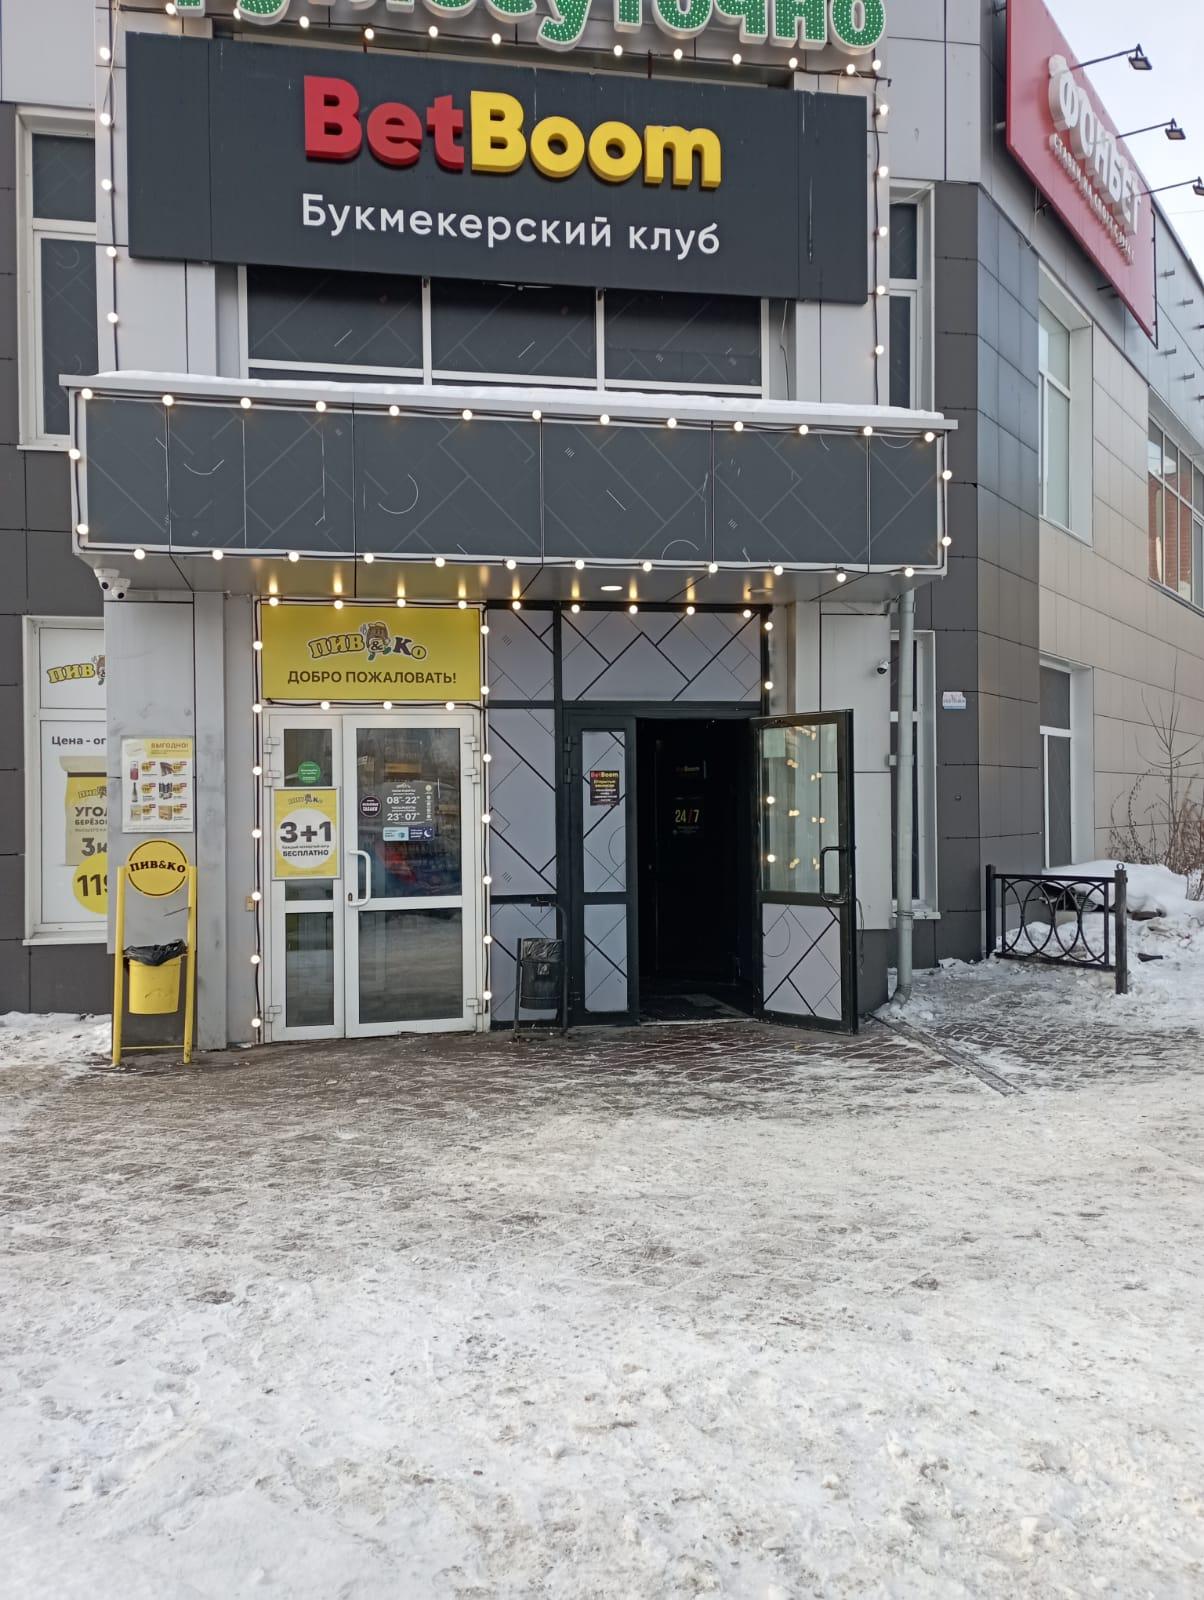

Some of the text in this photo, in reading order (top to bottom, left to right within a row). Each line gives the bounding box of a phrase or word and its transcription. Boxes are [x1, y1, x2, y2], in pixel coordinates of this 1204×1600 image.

[303, 75, 722, 190] BetBoom
[301, 192, 721, 260] Букмекерский клуб
[287, 670, 457, 684] ДОБРО ПОЖАЛОВАТЬ!
[51, 736, 84, 745] Цена
[675, 809, 700, 823] 24/7
[280, 821, 332, 843] 3+1
[282, 849, 329, 857] БЕСПЛАТНО
